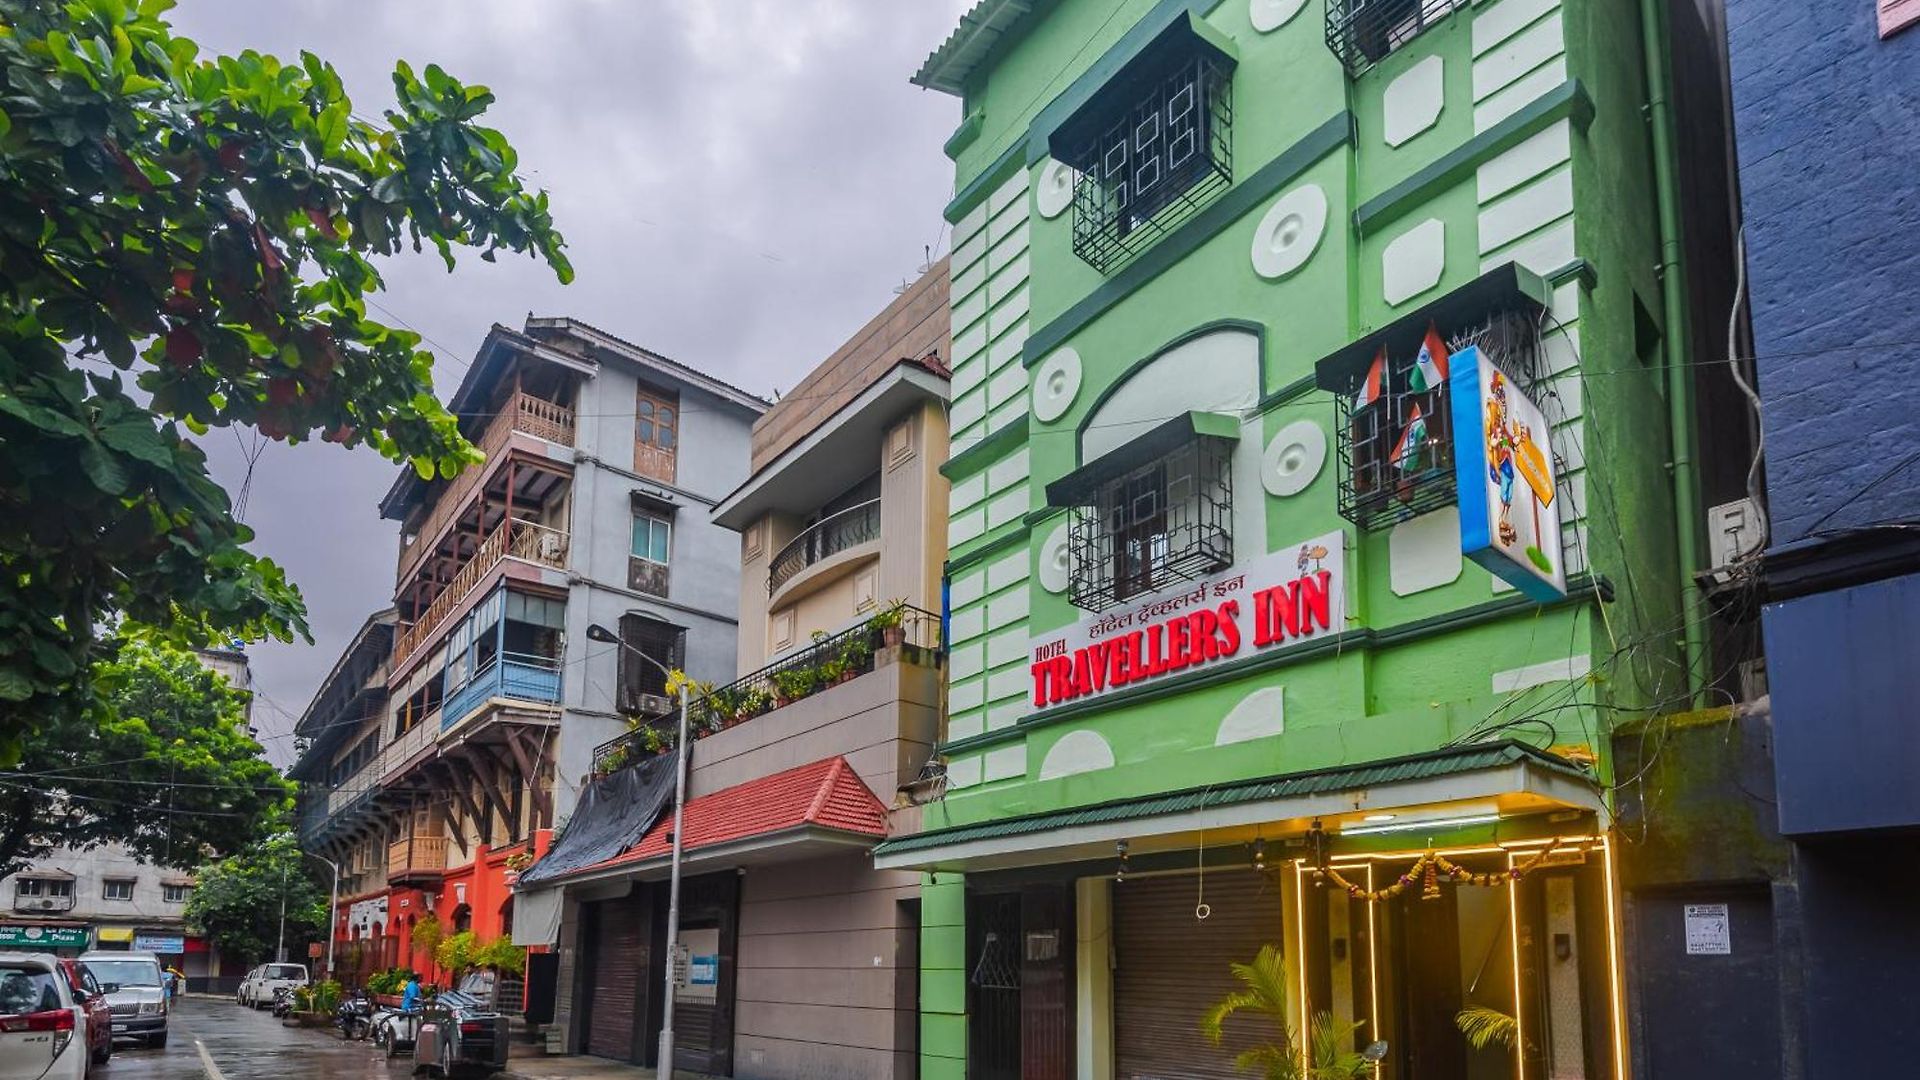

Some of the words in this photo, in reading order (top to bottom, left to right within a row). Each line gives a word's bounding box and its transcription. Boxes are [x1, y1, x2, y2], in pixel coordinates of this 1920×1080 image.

[1213, 574, 1246, 597] इन
[1031, 600, 1241, 706] TRAVELLERS
[1253, 571, 1332, 647] INN
[1035, 638, 1067, 662] HOTEL
